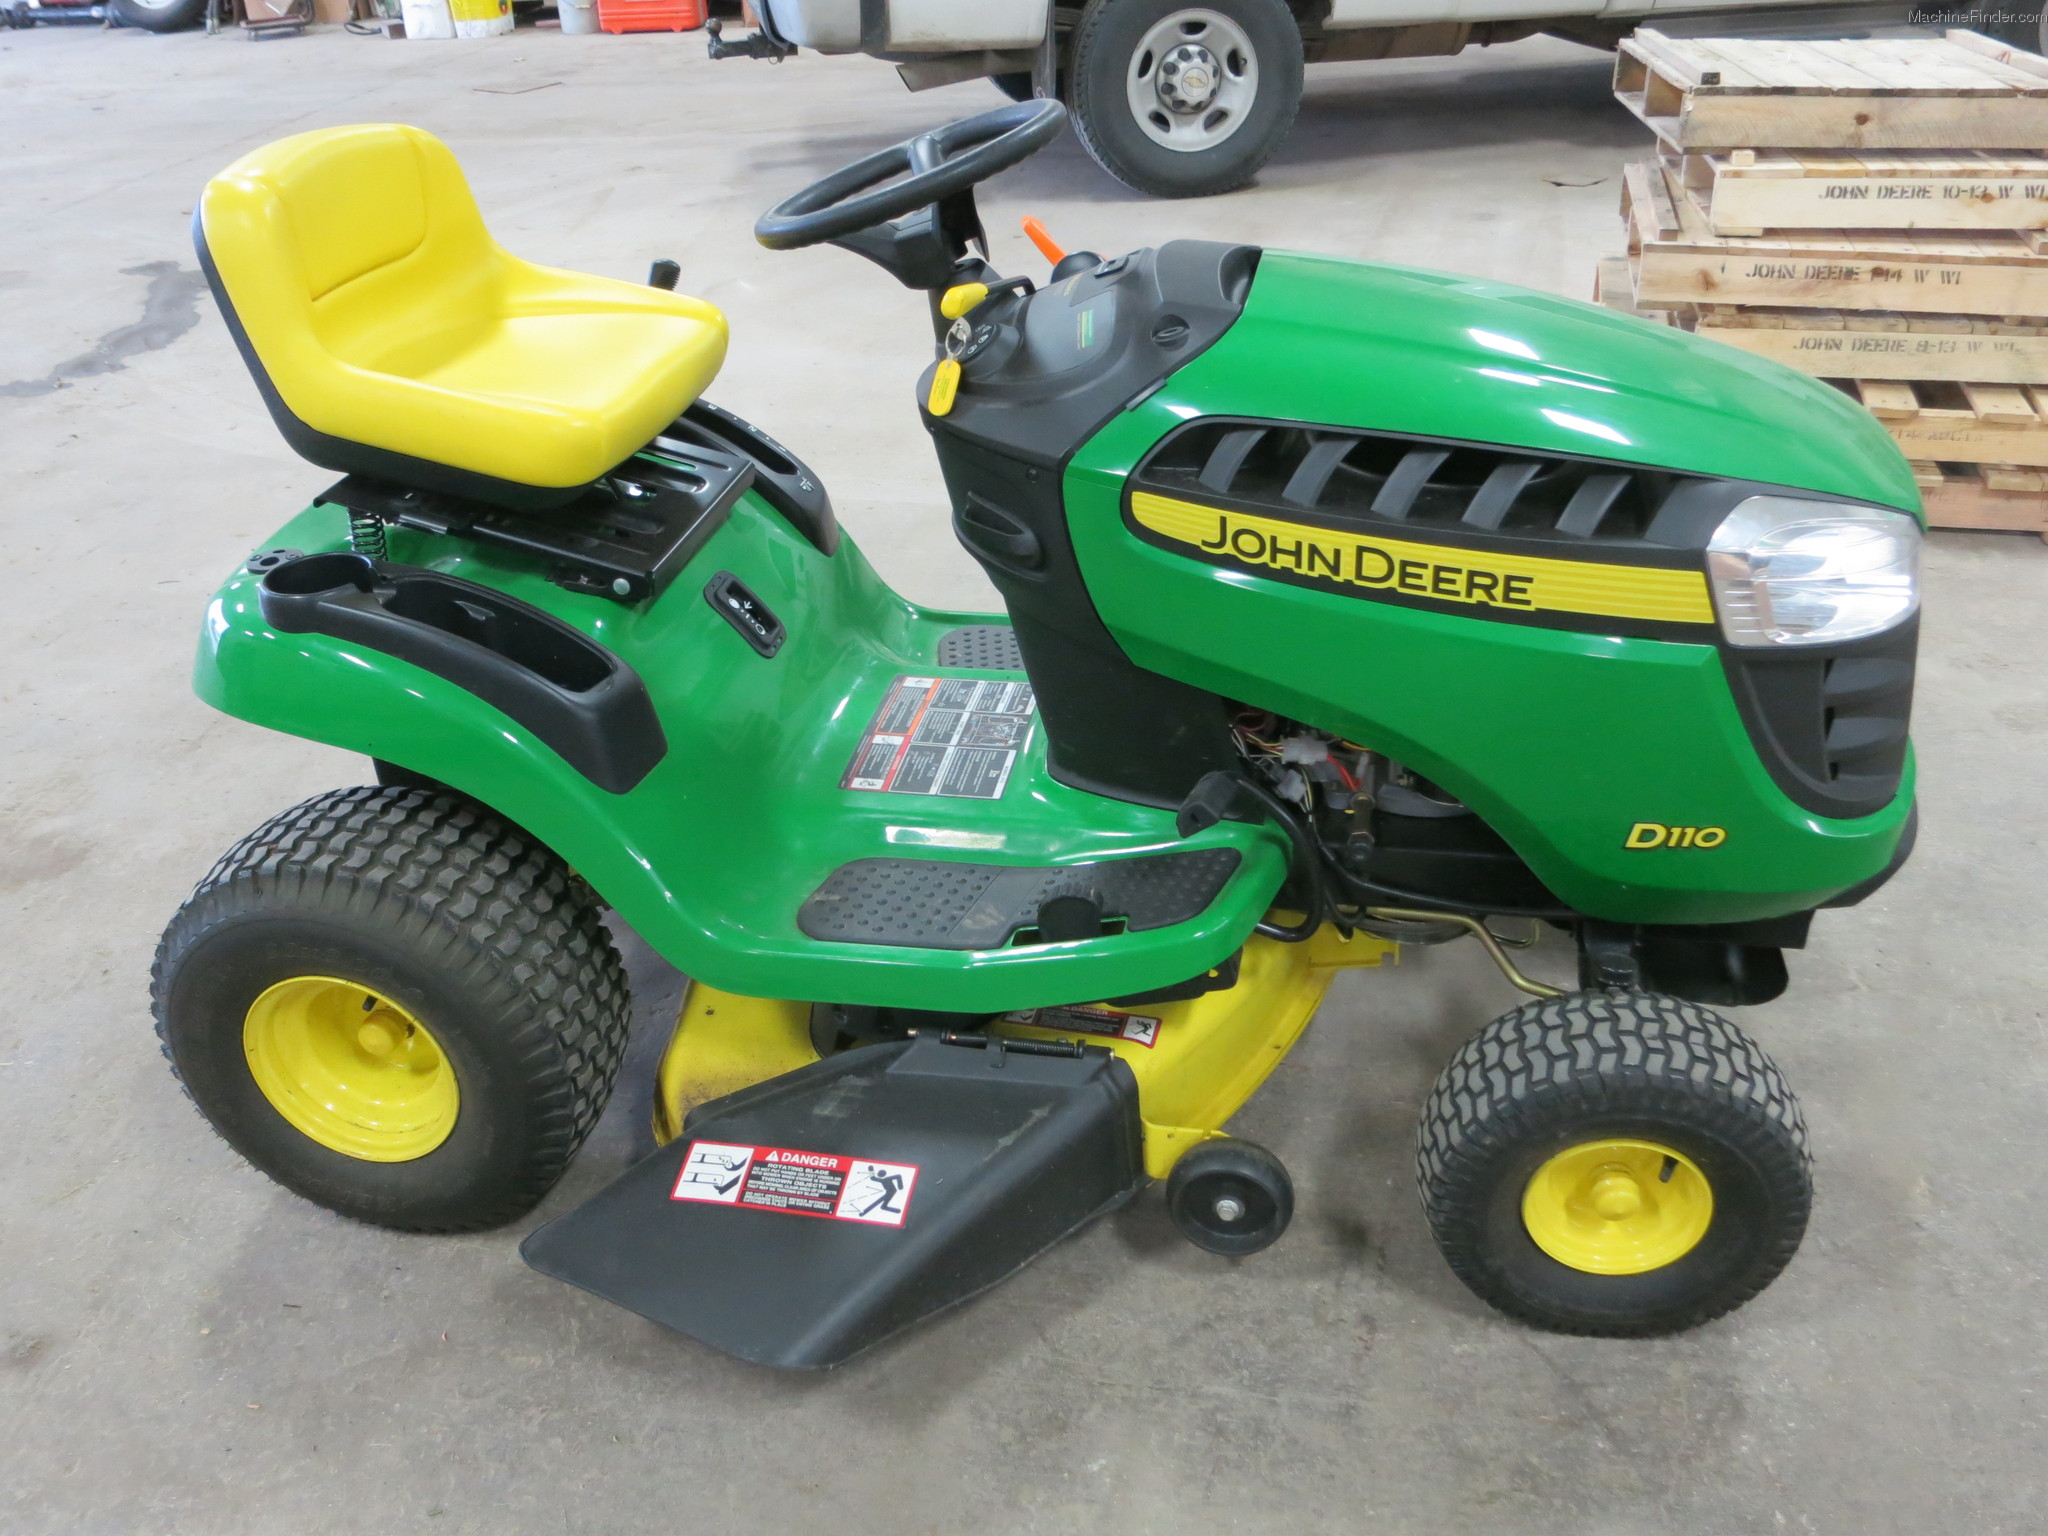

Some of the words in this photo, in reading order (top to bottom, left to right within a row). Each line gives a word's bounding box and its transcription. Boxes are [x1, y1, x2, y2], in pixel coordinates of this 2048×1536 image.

[1819, 185, 1869, 199] JOHN
[1876, 185, 1933, 199] DEERE
[1942, 185, 1988, 199] 10-13
[1999, 185, 2014, 199] W
[1746, 264, 1796, 279] JOHN
[1804, 265, 1860, 281] DEERE
[1914, 269, 1929, 283] W
[1793, 337, 1842, 350] JOHN
[1851, 338, 1908, 352] DEERE
[1201, 515, 1341, 577] JOHN
[1354, 544, 1534, 606] DEERE
[1624, 822, 1727, 849] D110
[767, 1163, 804, 1171] ROTATING
[781, 1152, 838, 1168] DANGER
[761, 1176, 793, 1184] THROWN
[794, 1180, 827, 1189] OBJECTS
